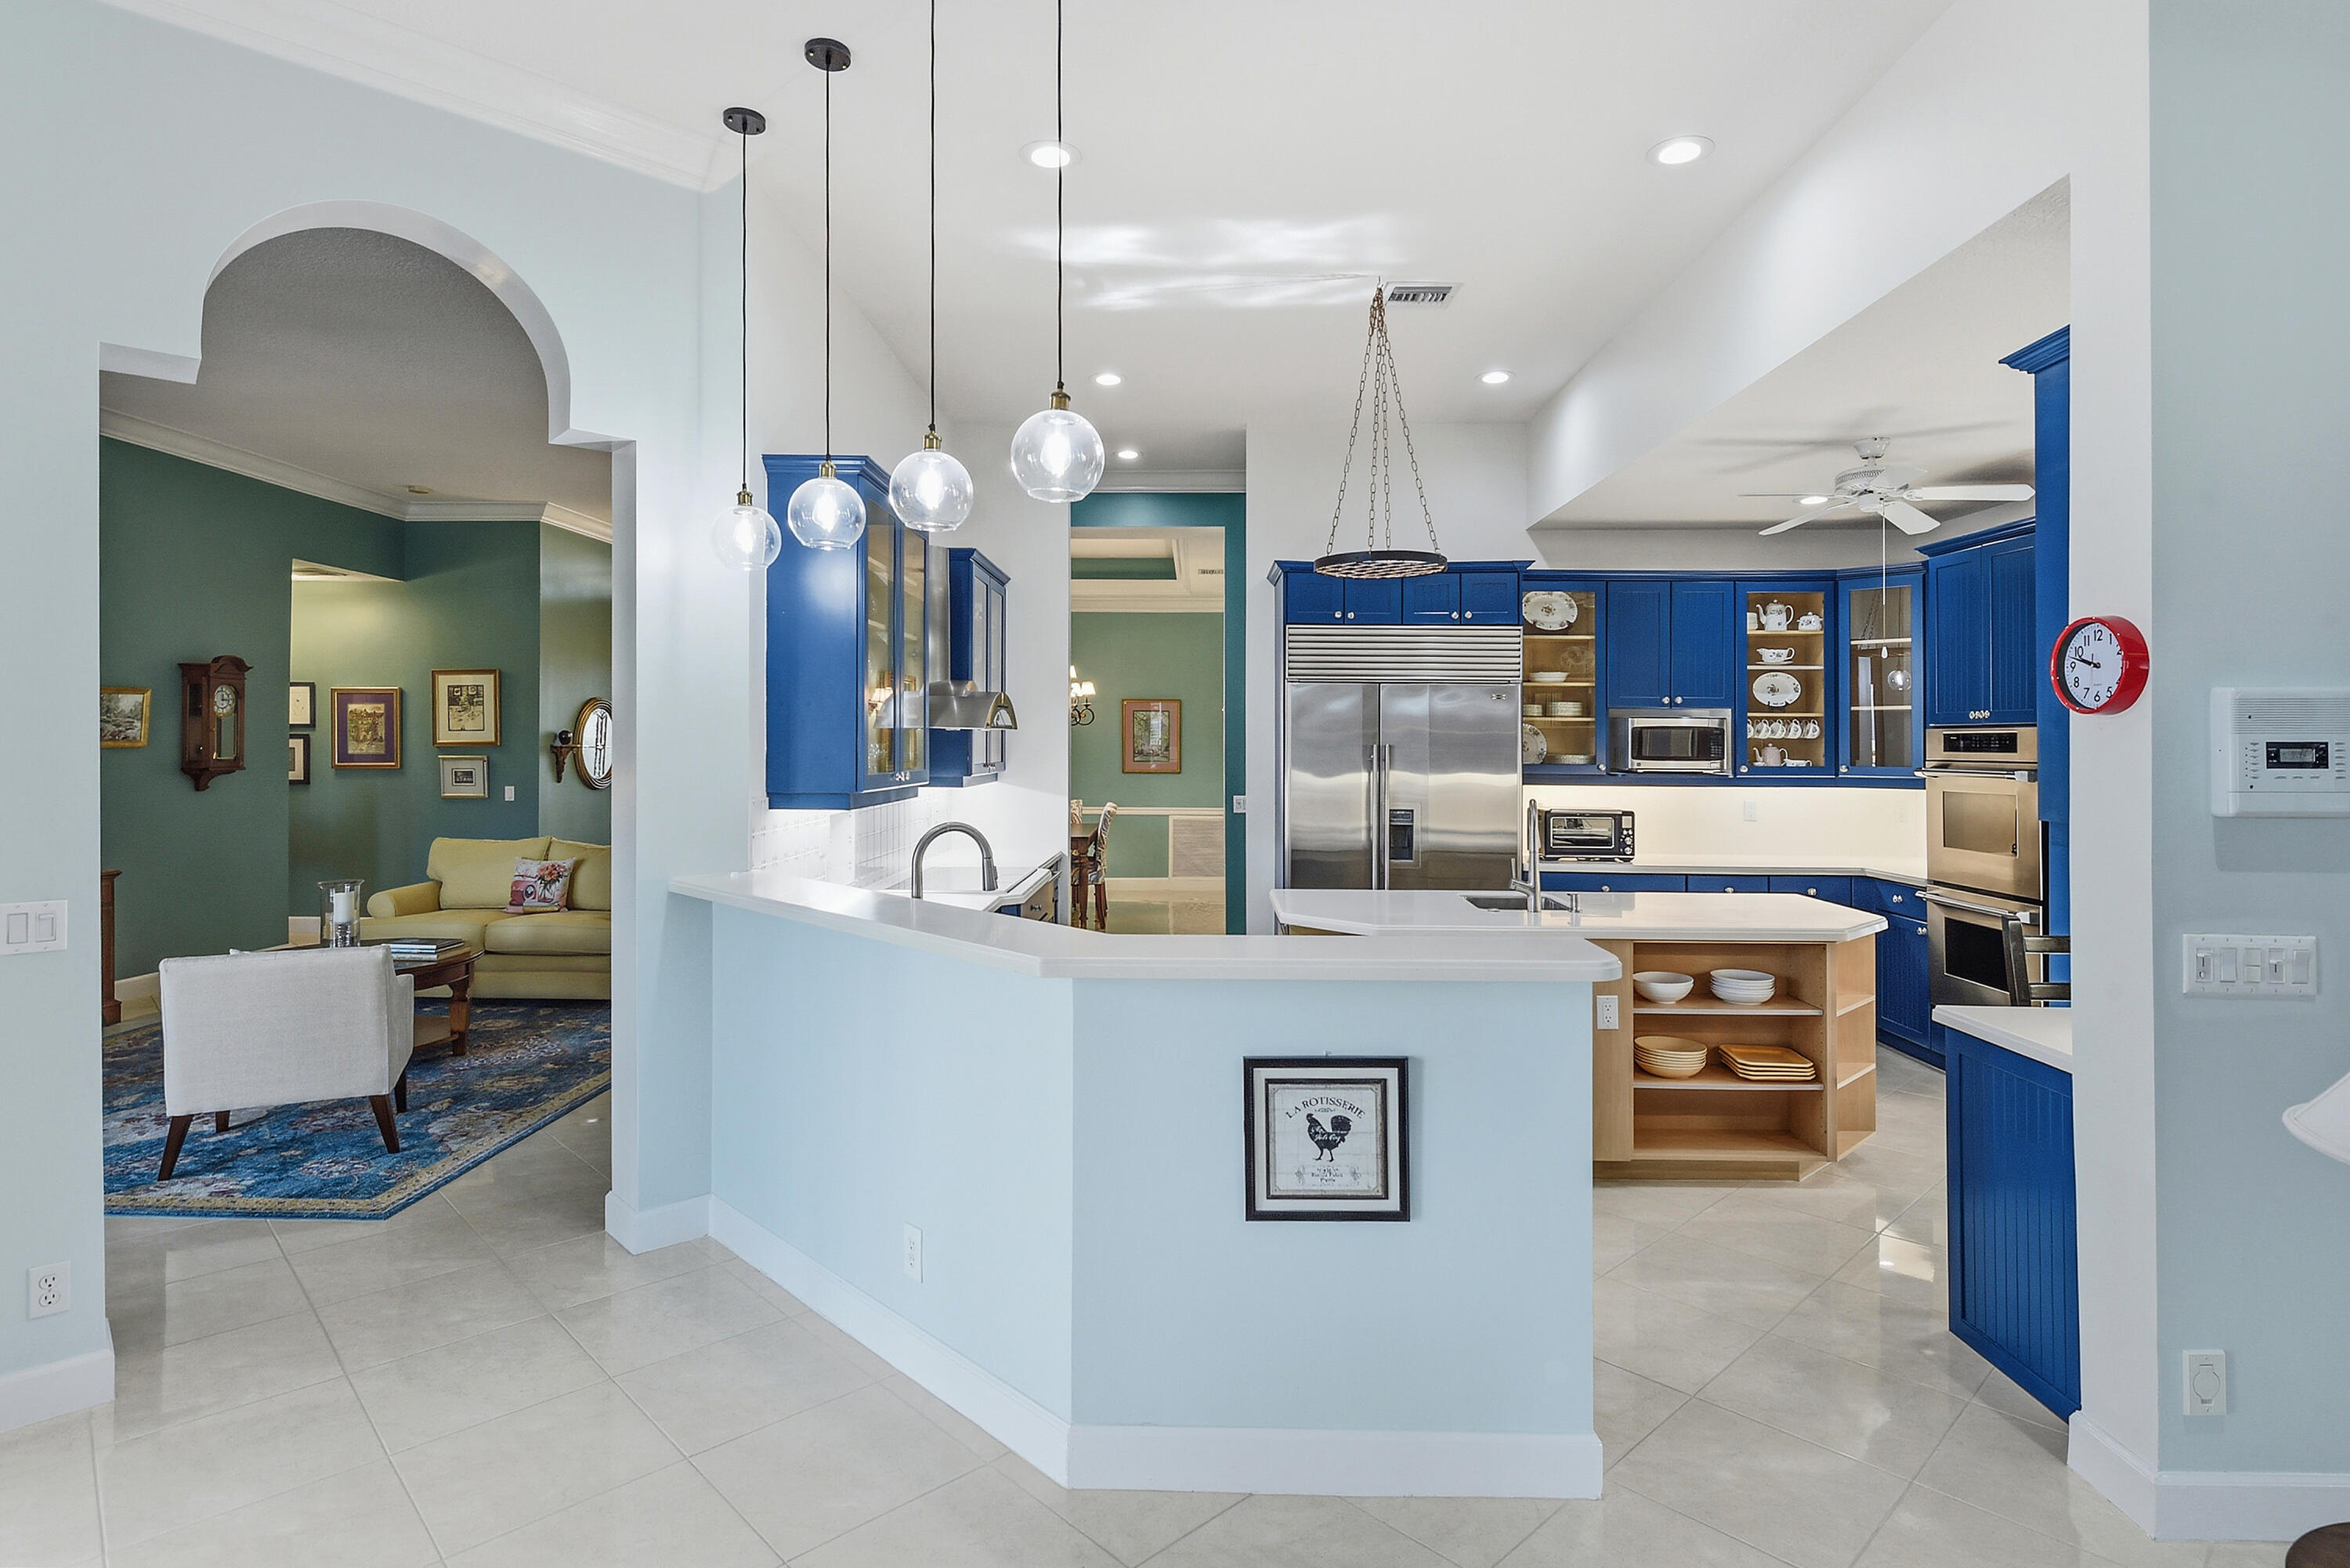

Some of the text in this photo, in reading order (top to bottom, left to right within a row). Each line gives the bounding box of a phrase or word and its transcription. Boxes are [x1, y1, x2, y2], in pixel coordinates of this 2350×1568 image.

[2084, 635, 2090, 646] 11
[2093, 629, 2103, 641] 12
[2109, 634, 2113, 645] 1
[2074, 645, 2084, 658] 10
[2070, 661, 2076, 672] 9
[2073, 676, 2080, 688] 8
[2084, 687, 2090, 699] 7
[2093, 691, 2100, 702] 6
[2106, 686, 2113, 698] 5
[1285, 1097, 1366, 1119] LA ROTISSERIE
